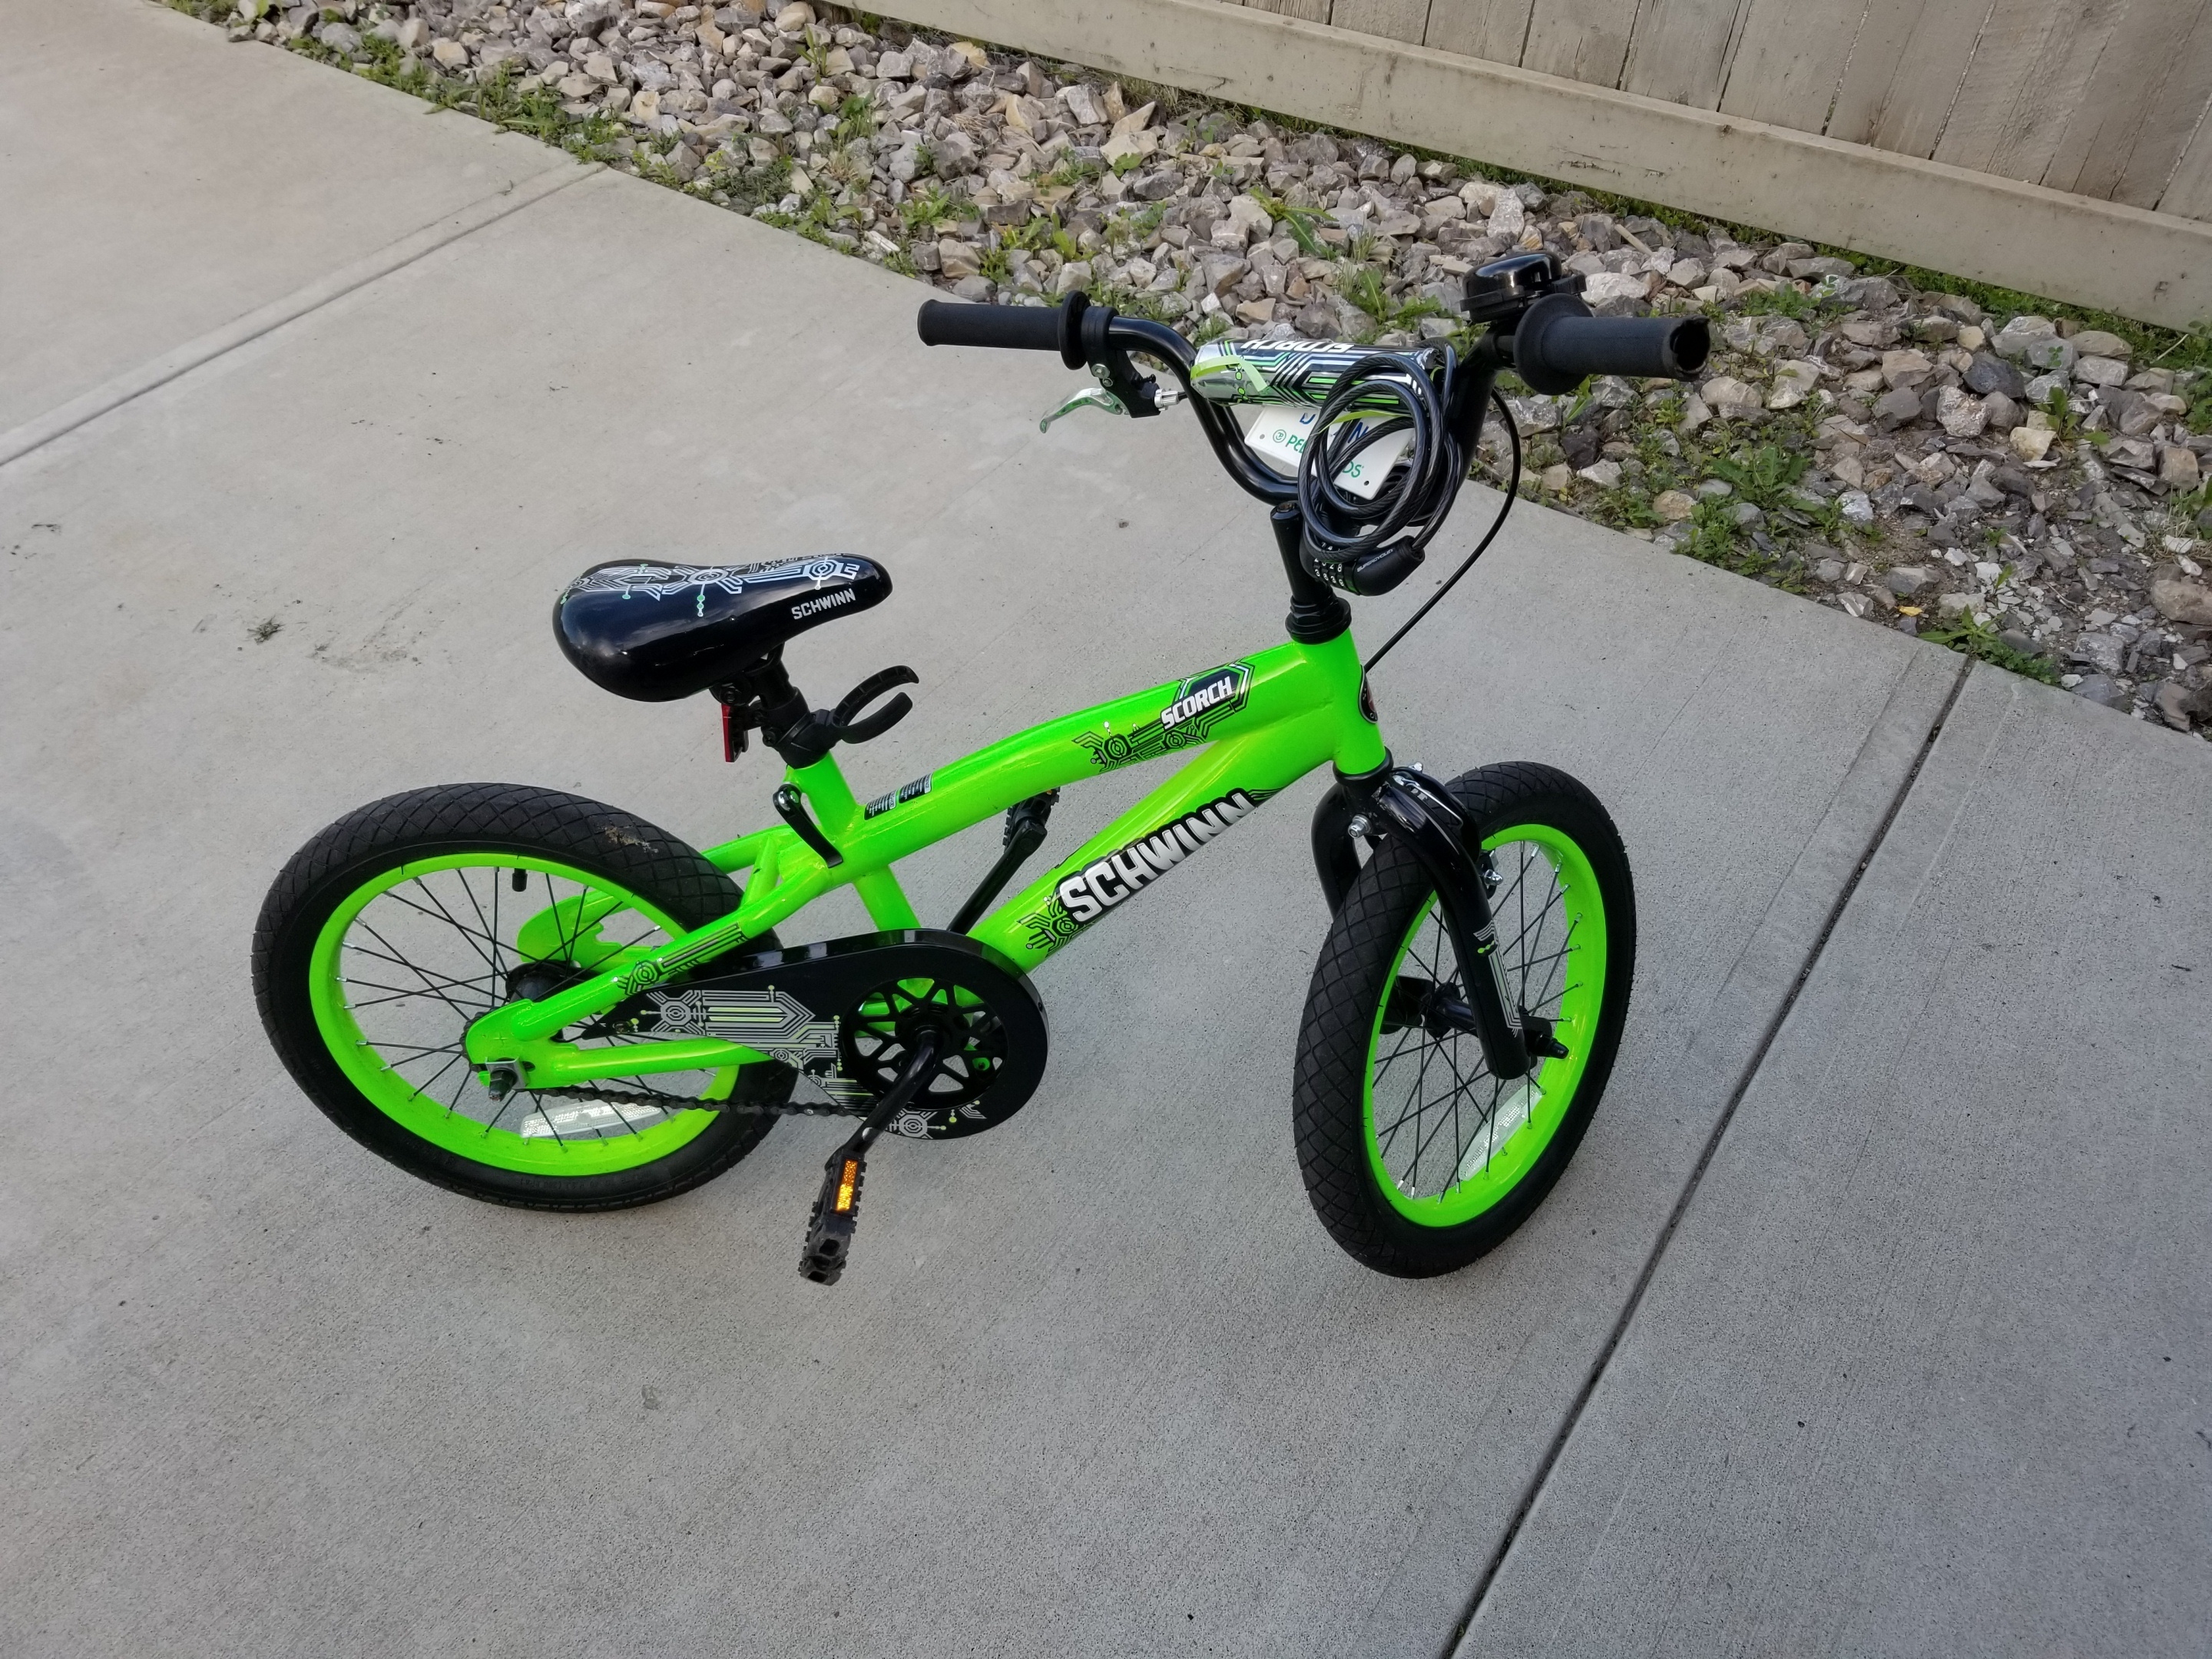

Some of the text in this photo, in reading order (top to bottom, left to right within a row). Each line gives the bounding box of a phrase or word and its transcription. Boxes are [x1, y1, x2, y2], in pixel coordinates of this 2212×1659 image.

[791, 588, 856, 620] SCHWINN
[1161, 676, 1233, 730] SCORCH
[1059, 792, 1257, 922] SCHWINN
